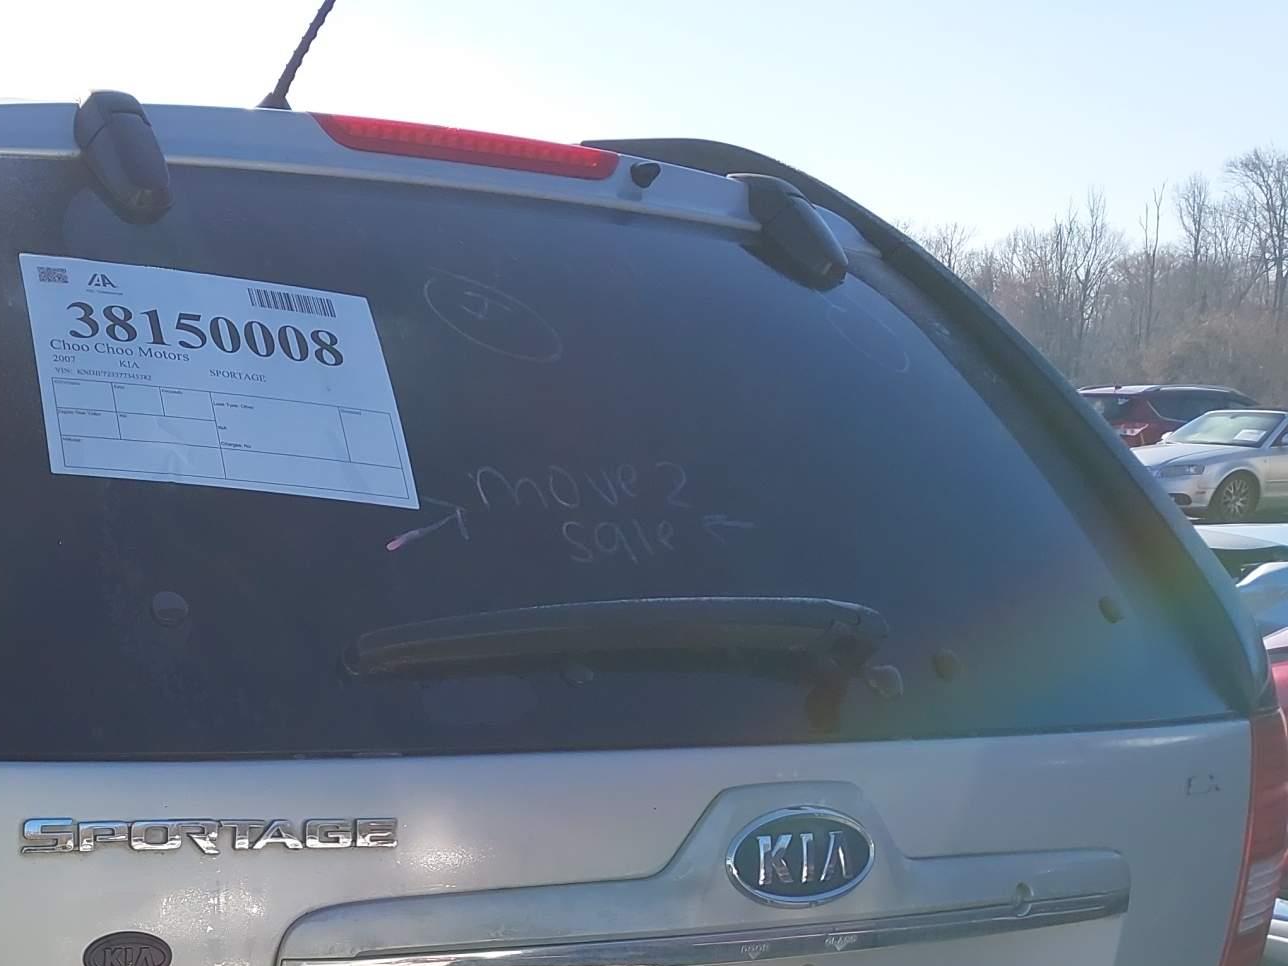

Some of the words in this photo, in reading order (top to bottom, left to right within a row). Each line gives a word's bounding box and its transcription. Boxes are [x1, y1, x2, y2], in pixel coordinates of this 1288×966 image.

[50, 338, 90, 353] Choo
[95, 342, 134, 357] Choo
[139, 346, 190, 363] Motors
[66, 301, 344, 367] 38150008
[119, 359, 141, 370] KIA
[208, 368, 267, 383] SPORTAGE
[654, 460, 695, 510] 2
[19, 816, 399, 855] SPORTAGE
[756, 830, 853, 887] KIA
